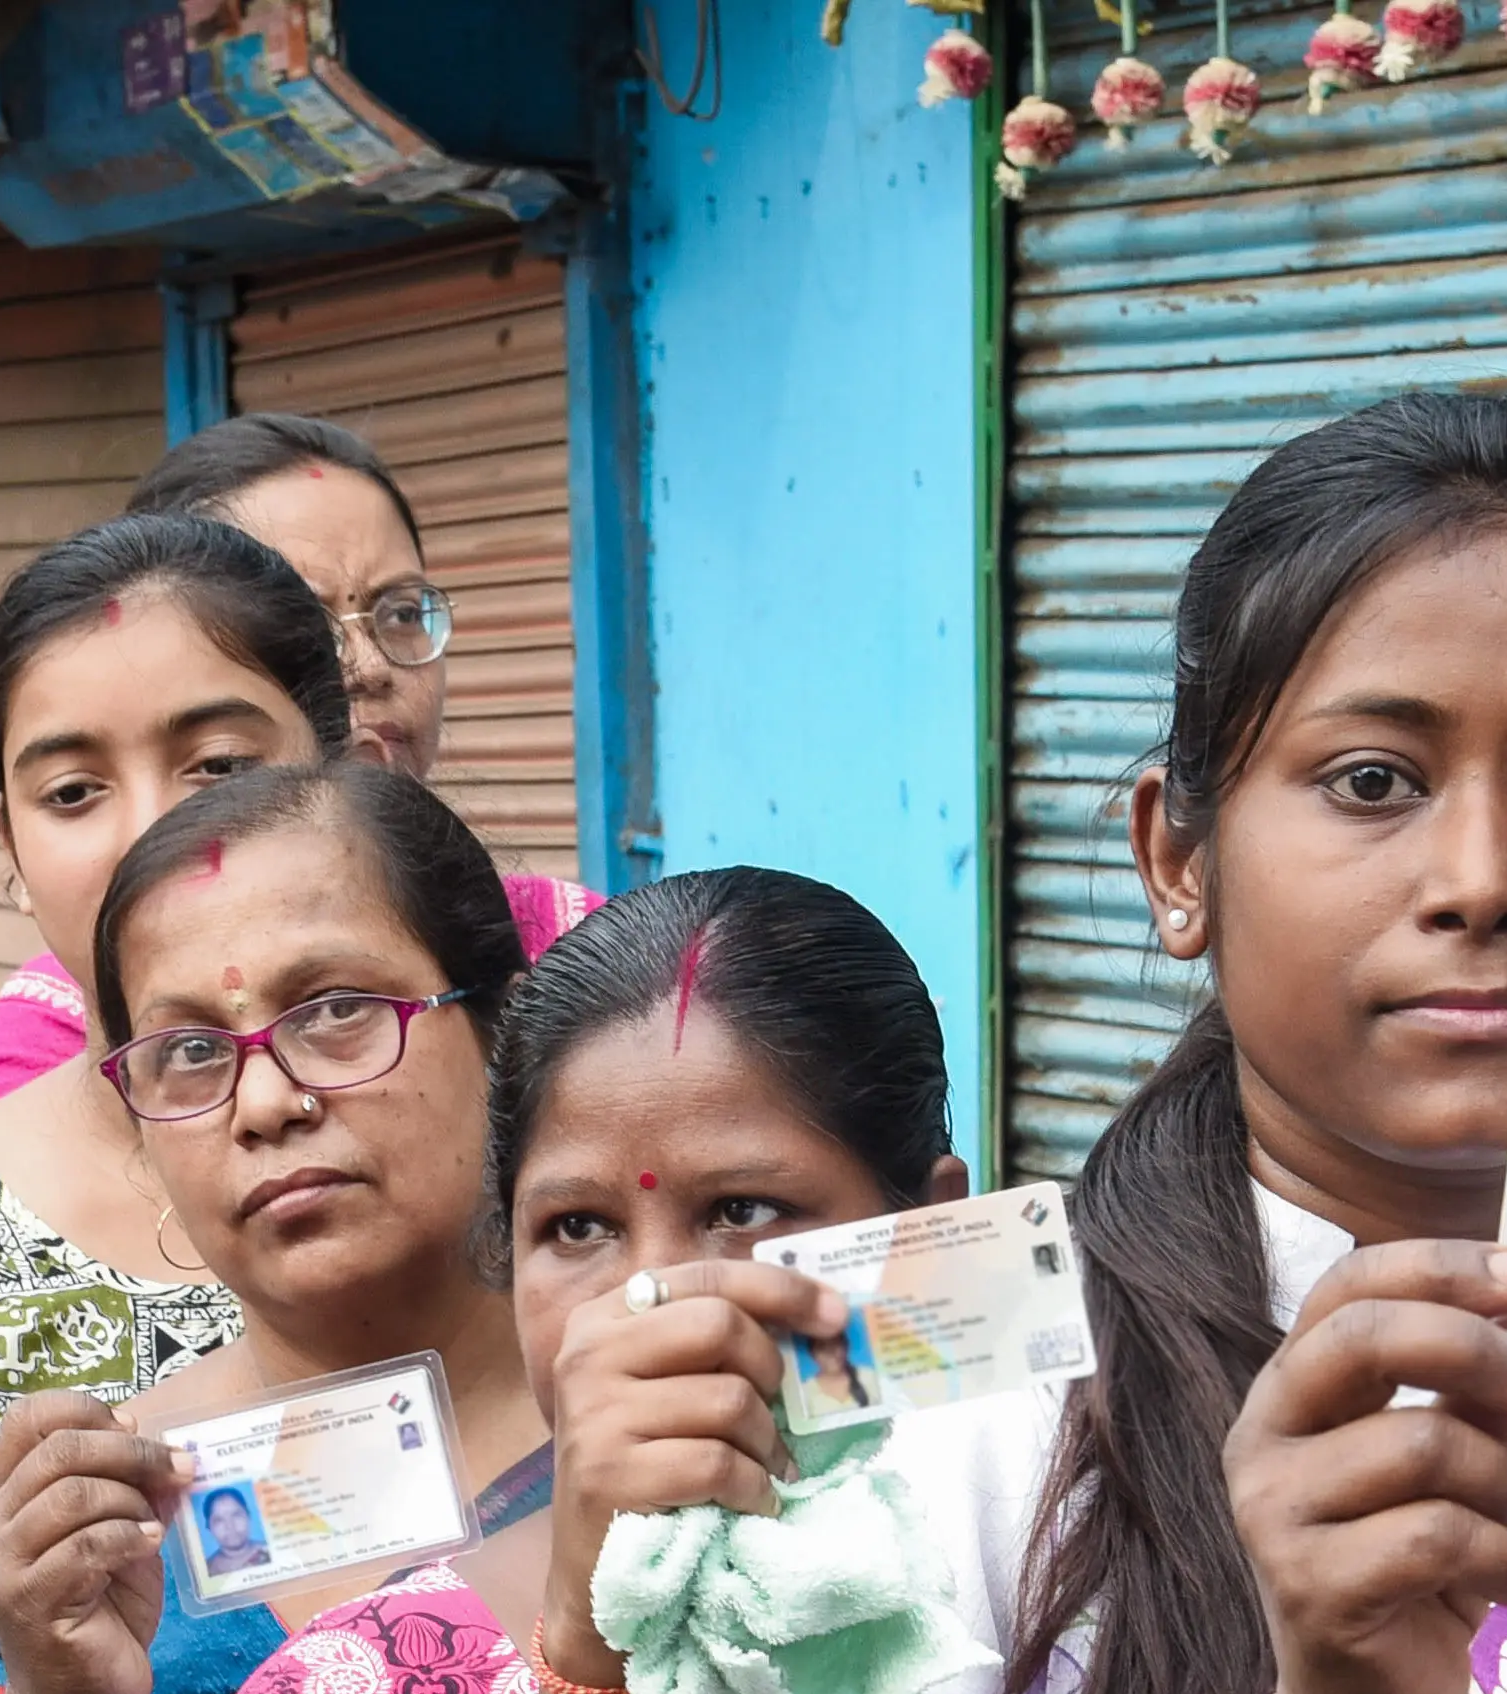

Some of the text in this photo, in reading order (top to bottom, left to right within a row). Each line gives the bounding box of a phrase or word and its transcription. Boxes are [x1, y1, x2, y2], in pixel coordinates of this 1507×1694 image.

[819, 1219, 993, 1262] ELECTION COMMISSION OF INDIA
[216, 1411, 374, 1458] ELECTION COMMISSION OF INDIA
